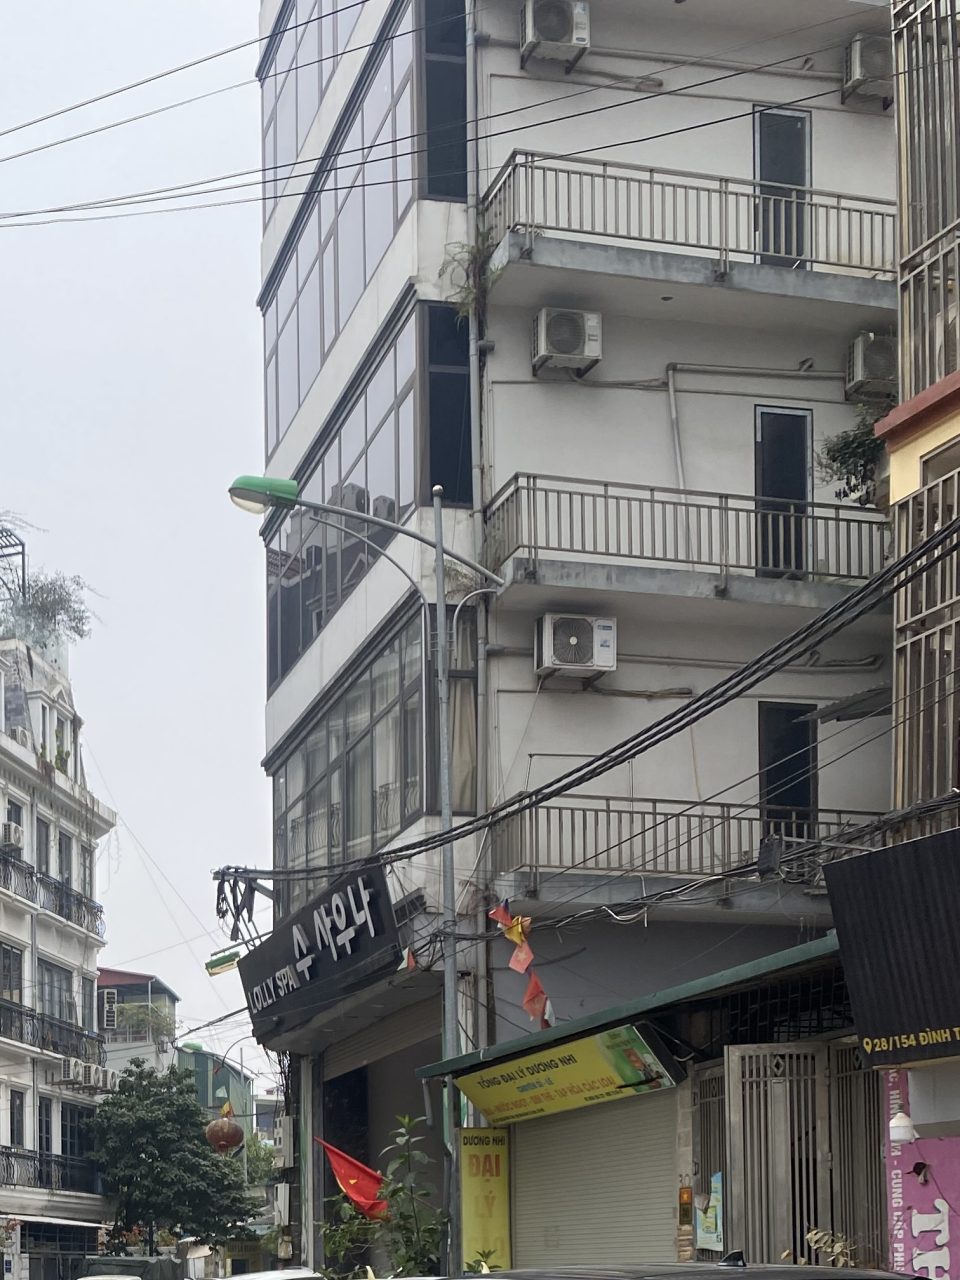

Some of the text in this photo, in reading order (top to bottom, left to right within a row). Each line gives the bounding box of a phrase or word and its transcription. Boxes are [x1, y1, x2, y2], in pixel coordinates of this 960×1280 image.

[313, 875, 375, 962] 사우나
[248, 965, 298, 1015] LOLLY SPA
[873, 1033, 917, 1051] 28/154
[919, 1028, 951, 1046] ĐÌNH
[514, 1065, 527, 1079] LÝ
[557, 1054, 578, 1067] NHI
[463, 1135, 506, 1146] DƯƠNG NHI
[468, 1153, 501, 1182] ĐẠI
[891, 1169, 904, 1208] CUNG
